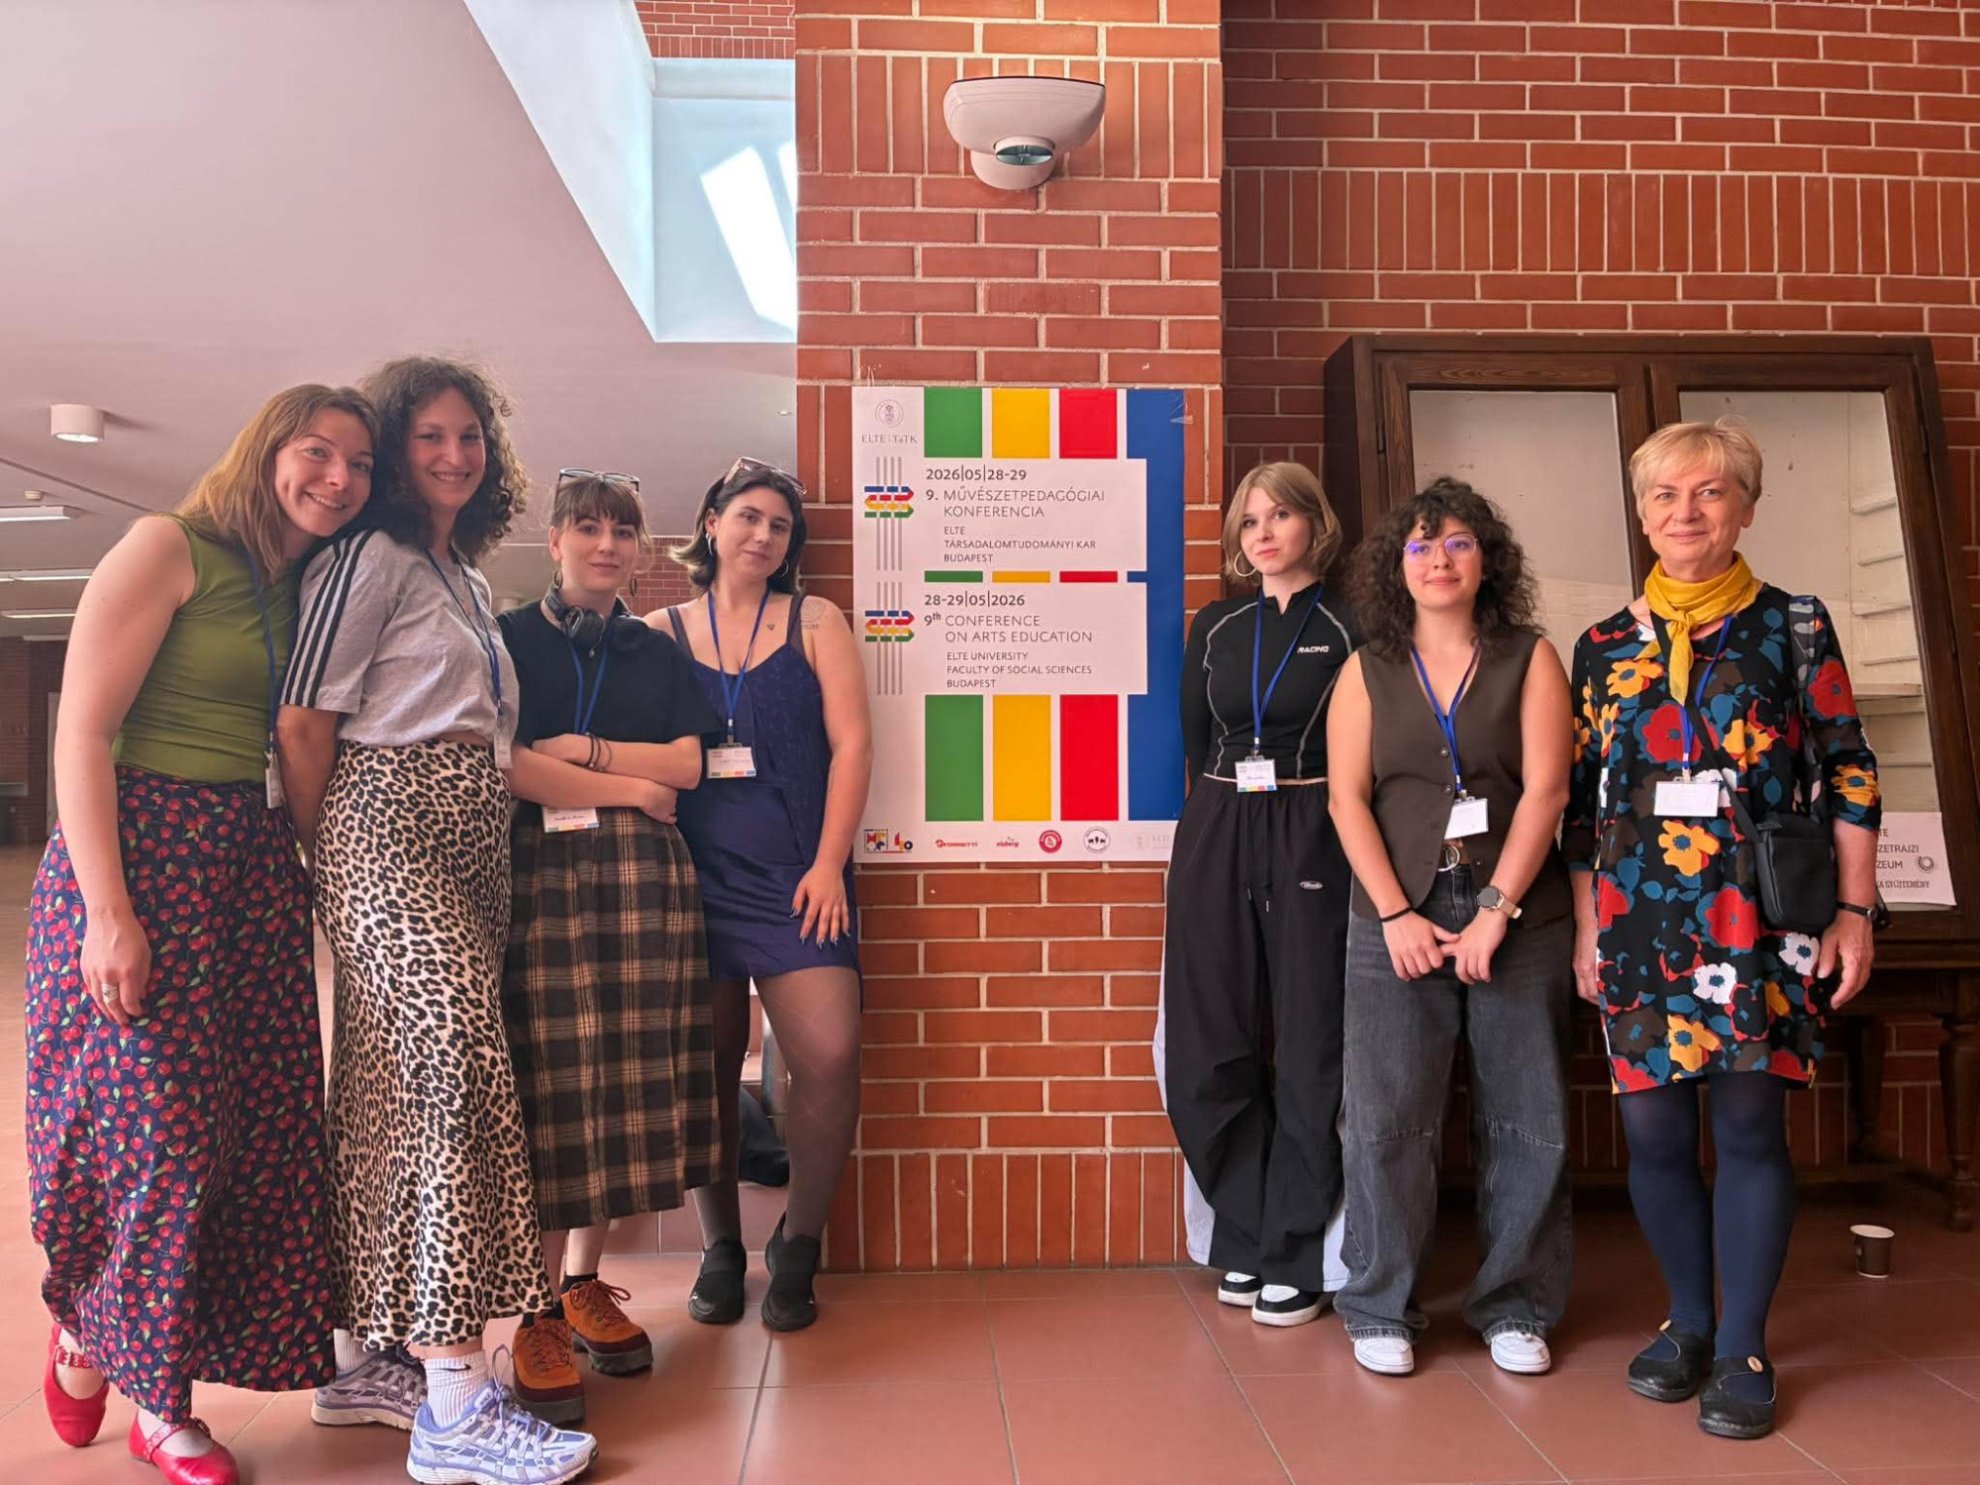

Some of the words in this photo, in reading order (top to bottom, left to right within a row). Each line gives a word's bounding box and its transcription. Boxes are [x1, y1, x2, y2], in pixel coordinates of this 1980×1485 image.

[862, 434, 886, 444] ELTE
[926, 489, 938, 501] 9.
[944, 485, 1105, 502] MŰVÉSZETPEDAGÓGIAI
[944, 506, 1044, 518] KONFERENCIA
[944, 526, 965, 535] ELTE
[944, 539, 1074, 549] TÁRSADALOMTUDOMÁNYI
[1076, 540, 1096, 549] KAR
[944, 553, 994, 562] BUDAPEST
[924, 612, 941, 626] 9th
[945, 615, 1040, 626] CONFERENCE
[945, 631, 967, 643] ON
[971, 631, 1006, 643] ARTS
[1011, 631, 1093, 643] EDUCATION
[1297, 645, 1330, 654] RACING
[947, 652, 968, 660] ELTE
[971, 652, 1028, 660] UNIVERSITY
[947, 665, 989, 674] FACULTY
[992, 665, 1005, 674] OF
[1007, 665, 1043, 674] SOCIAL
[1045, 665, 1092, 674] SCIENCES
[947, 679, 996, 688] BUDAPEST
